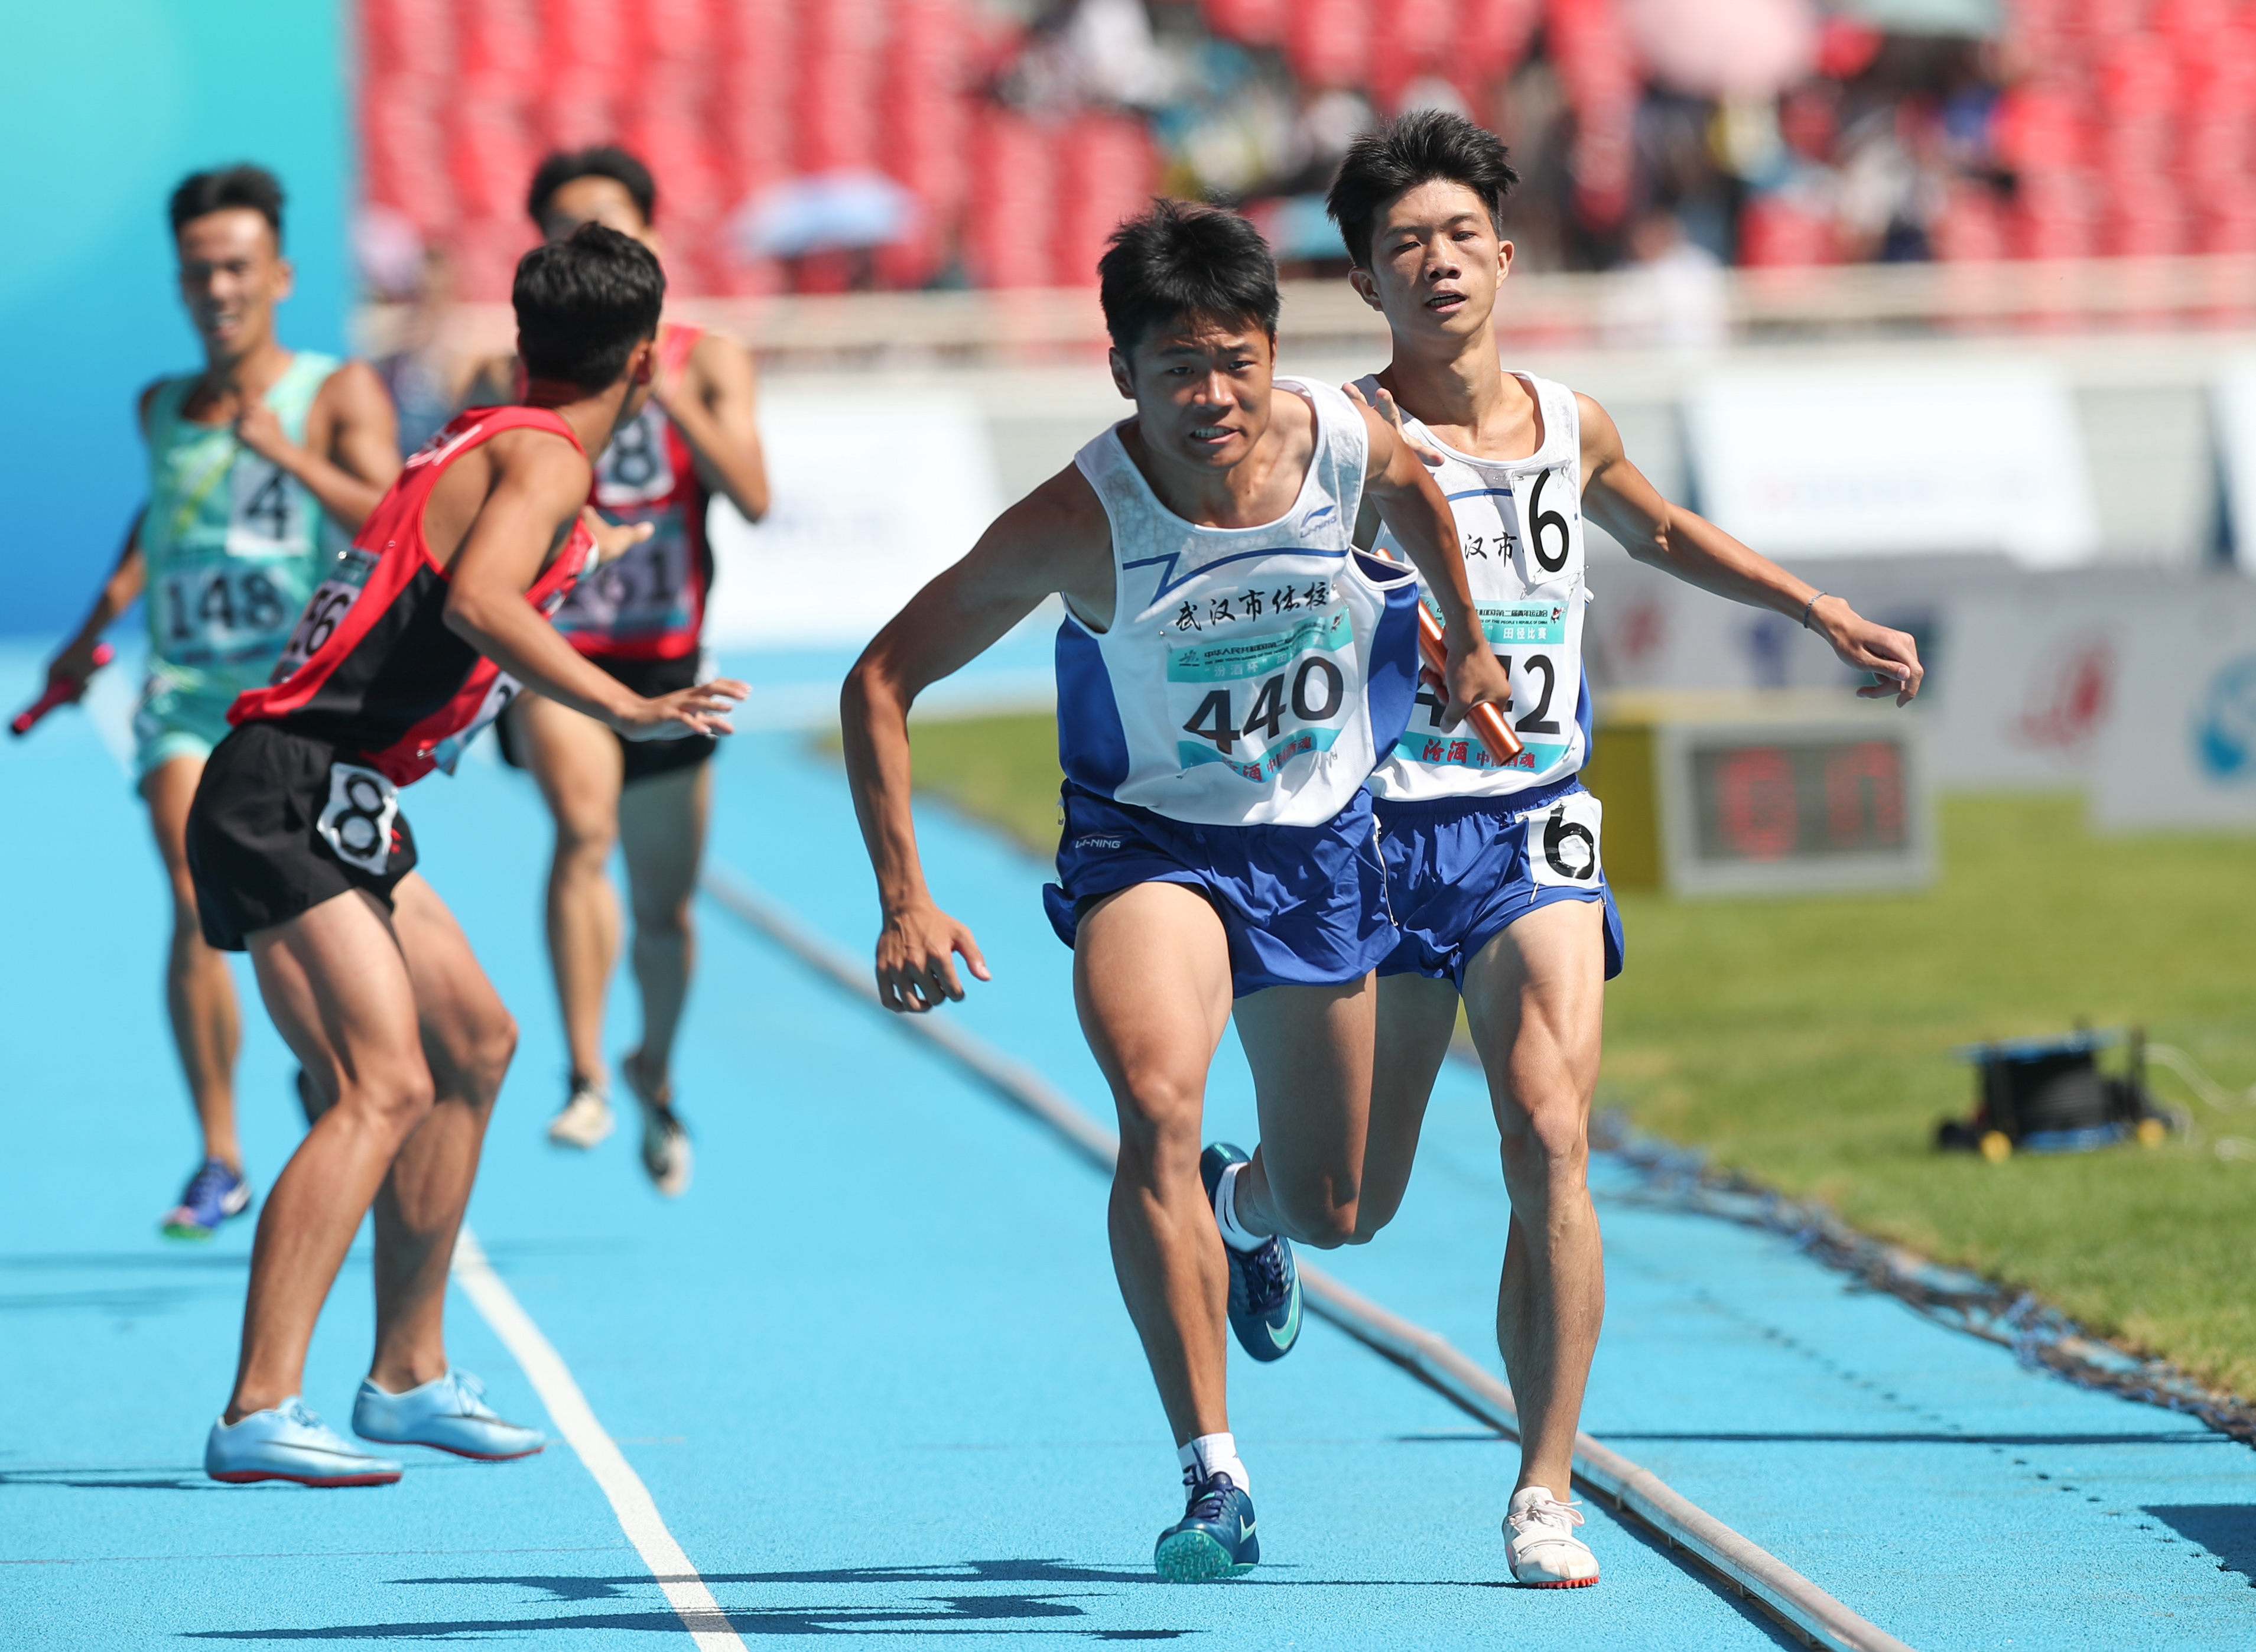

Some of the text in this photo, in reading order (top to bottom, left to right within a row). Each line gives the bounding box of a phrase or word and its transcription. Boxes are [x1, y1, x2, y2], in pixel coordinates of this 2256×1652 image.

[612, 415, 657, 486] 8
[247, 471, 287, 541] 4
[1529, 467, 1569, 573] 6
[169, 570, 285, 642] 148
[1175, 581, 1329, 631] 武汉市体校
[1503, 627, 1547, 640] 田径比赛
[1183, 656, 1343, 755] 440
[1422, 738, 1470, 764] 汾酒
[333, 773, 386, 860] 8
[1075, 839, 1122, 848] LI-NING
[1543, 807, 1595, 880] 6
